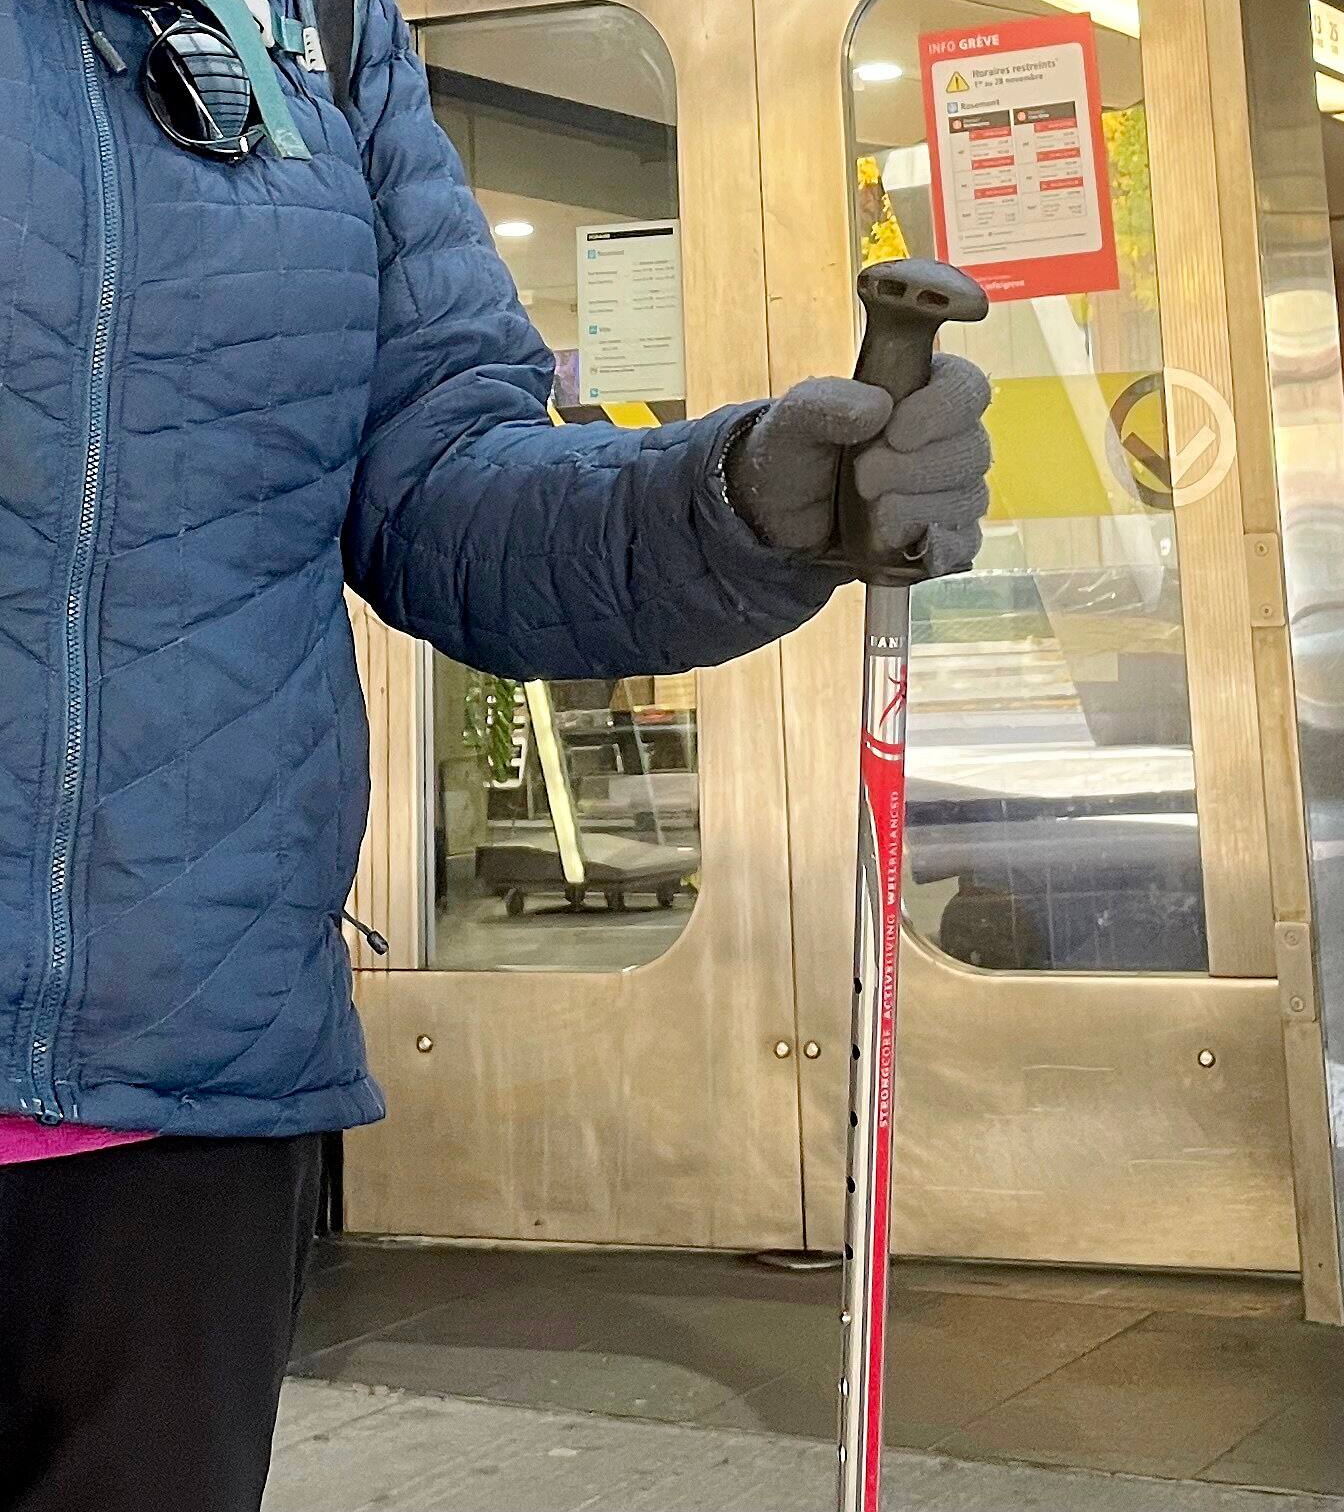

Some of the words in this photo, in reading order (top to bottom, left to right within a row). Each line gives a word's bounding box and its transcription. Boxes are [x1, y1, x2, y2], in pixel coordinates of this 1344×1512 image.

[928, 40, 956, 55] INFO
[972, 66, 1011, 79] Horaires
[879, 1027, 892, 1128] STRONGCORE
